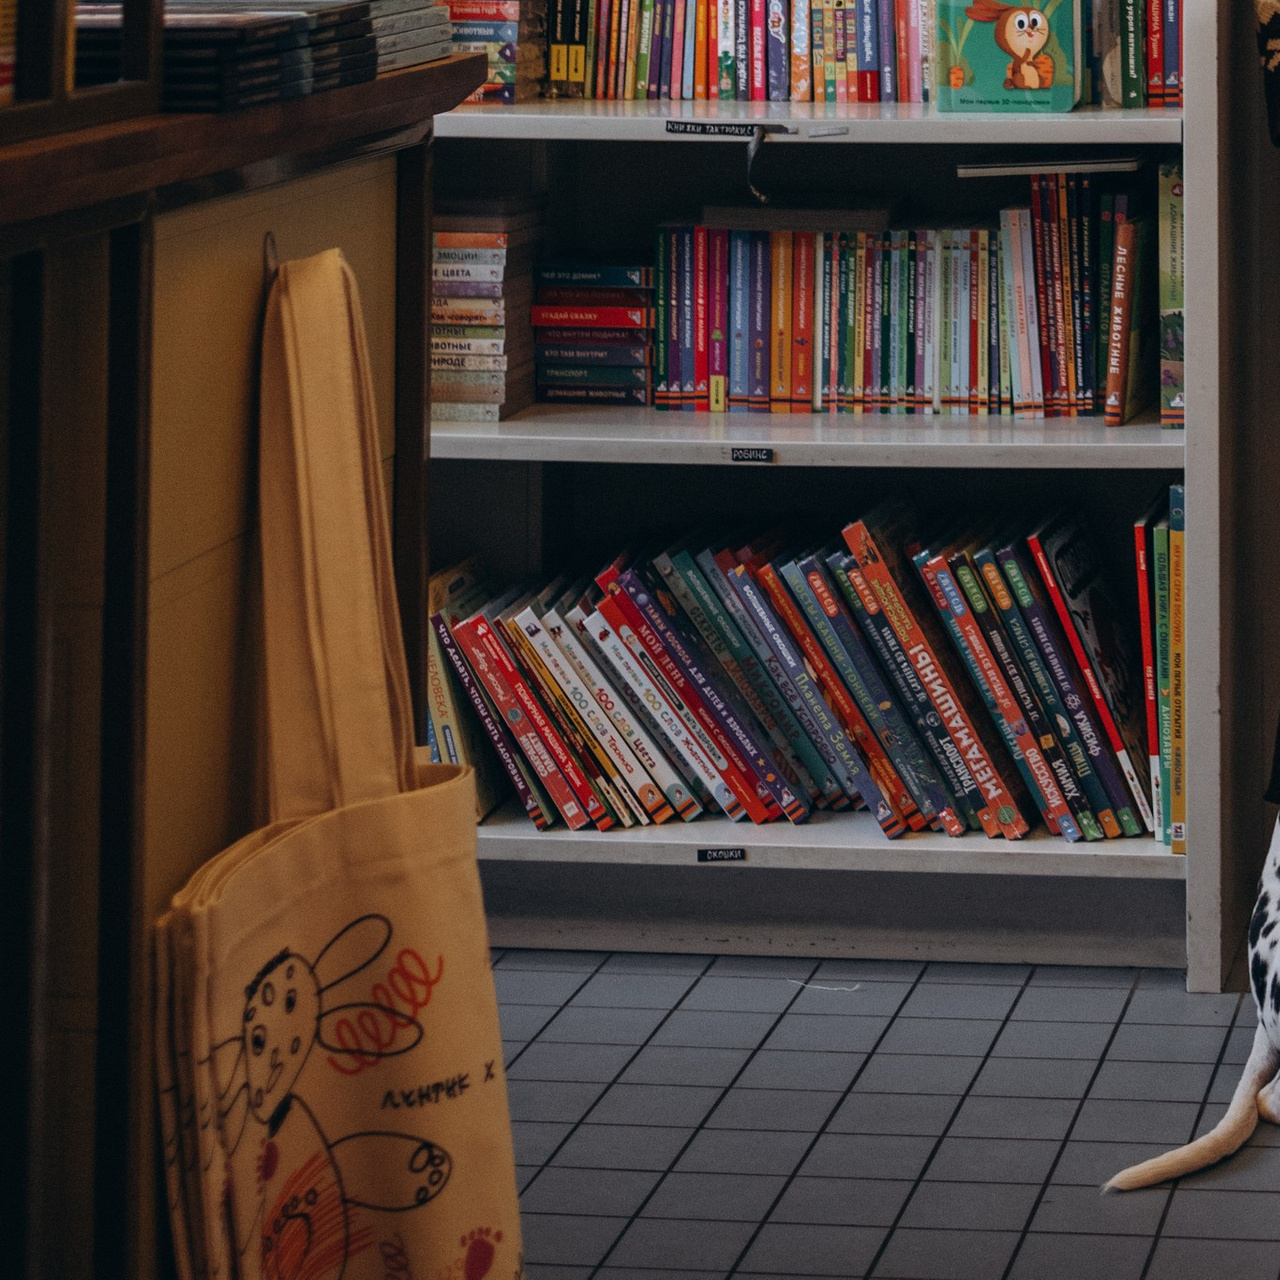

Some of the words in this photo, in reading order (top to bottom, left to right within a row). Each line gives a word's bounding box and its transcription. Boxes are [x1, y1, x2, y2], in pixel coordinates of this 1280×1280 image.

[1125, 6, 1134, 31] украл
[1126, 33, 1136, 78] пятнышки?
[1151, 33, 1159, 58] Тушик
[1169, 203, 1177, 254] ДОМАШНИЕ
[436, 252, 477, 260] ЭМОЦИИ
[442, 269, 470, 277] ЦВЕТА
[1114, 245, 1126, 298] ЛЕСНЫЕ
[541, 312, 567, 320] УГАДАЙ
[570, 312, 597, 320] СКАЗКУ
[1109, 305, 1122, 374] ЖИВОТНЫЕ
[1157, 552, 1168, 591] БОЛЬШАЯ
[868, 577, 913, 643] ПОТРЯСАЮЩИЕ
[880, 580, 916, 632] ПАНОРАМЫ
[1158, 594, 1168, 619] КНИГА
[433, 623, 453, 646] Что
[637, 623, 664, 656] МОЙ
[657, 651, 689, 690] ДЕНЬ
[785, 573, 819, 618] МОСТЫ
[814, 619, 846, 663] БАШНИ
[841, 666, 881, 721] ТОННЕЛИ
[1159, 631, 1169, 678] ОКОШКАМИ
[443, 644, 476, 687] делать,
[643, 602, 668, 633] ТАЙНЫ
[663, 628, 693, 668] КОСМОСА
[687, 664, 707, 687] ДЛЯ
[701, 682, 726, 713] ДЕТЕЙ
[725, 714, 759, 759] ВЗРОСЛЫХ
[740, 583, 777, 633] ВОЛШЕБНЫЕ
[769, 630, 798, 669] ОКОШКИ
[792, 671, 838, 733] Планета
[827, 728, 865, 776] Земля
[464, 685, 491, 718] ЧТОБЫ
[903, 641, 1008, 801] МЕГАМАШИНЫ
[482, 716, 503, 742] БЫТЬ
[513, 682, 546, 727] ПОЖАРНАЯ
[540, 725, 569, 764] МАШИНА
[562, 761, 584, 789] Тушик
[593, 686, 616, 713] 100
[610, 708, 636, 740] СЛОВ
[630, 736, 659, 771] Цвета
[682, 710, 701, 734] БЫТЬ
[695, 729, 723, 765] ЗДОРОВЫМ
[1068, 709, 1107, 758] ФИЗИКА
[1160, 705, 1171, 768] ДИНОЗАВРЫ
[492, 740, 530, 791] ЗДОРОВЫМ
[934, 733, 980, 795] ТРАНСПОРТ
[1021, 745, 1067, 808] ИСКУССТВО
[1048, 757, 1083, 801] ХИМИЯ
[1063, 739, 1095, 778] ПТИЦЫ
